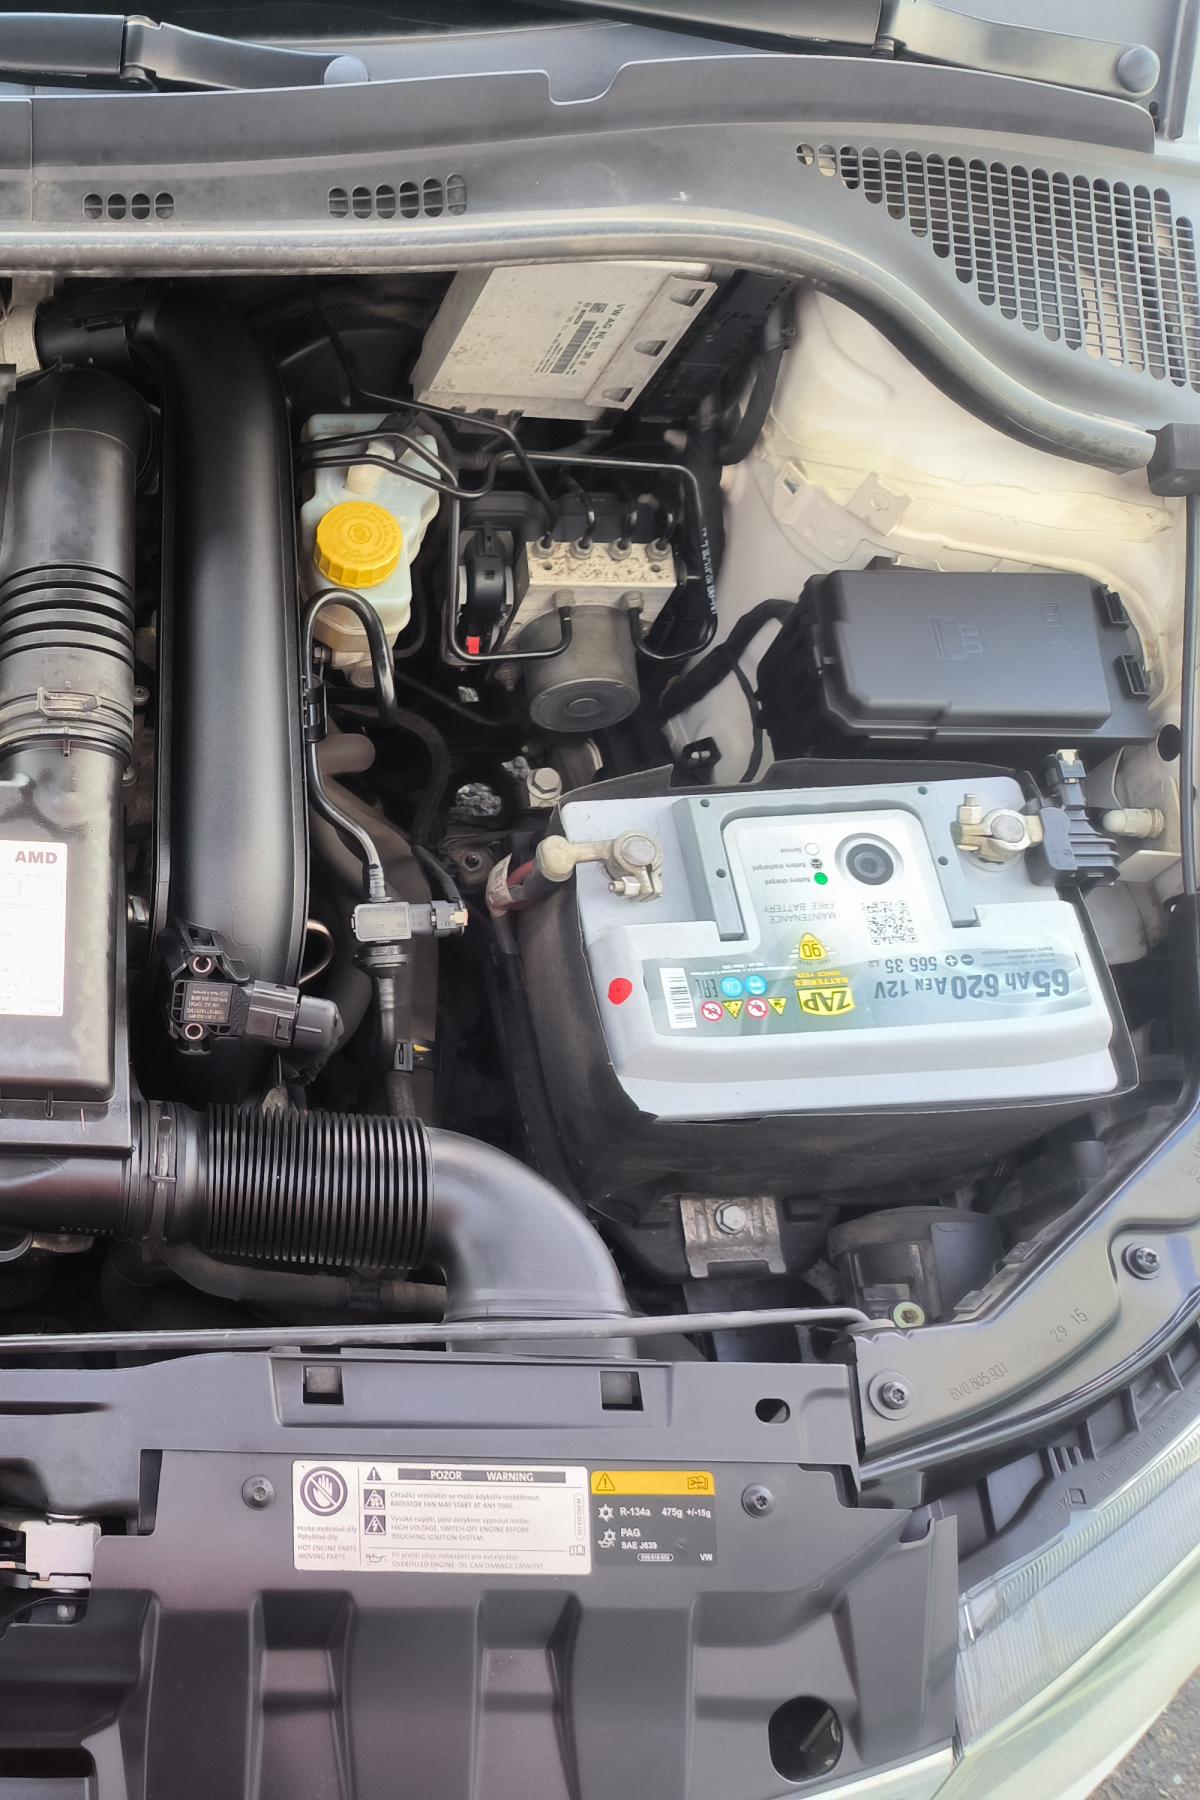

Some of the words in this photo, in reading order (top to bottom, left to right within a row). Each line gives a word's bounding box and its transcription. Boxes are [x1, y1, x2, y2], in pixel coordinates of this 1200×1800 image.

[611, 304, 626, 316] VW
[15, 850, 58, 864] AMD
[764, 902, 806, 913] BATTERY
[812, 901, 835, 910] FREE
[770, 912, 837, 924] MAINTENANCE
[802, 943, 822, 958] 90
[885, 958, 903, 974] 35
[909, 956, 937, 972] 565
[794, 976, 849, 987] BATTERIES
[874, 979, 909, 1000] 12V
[803, 990, 851, 1012] ZAP
[1050, 1325, 1068, 1342] 29
[1070, 1307, 1088, 1326] 15
[430, 1470, 462, 1480] POZOR
[485, 1472, 534, 1482] WARNING
[619, 1506, 651, 1516] R-134a
[661, 1507, 683, 1519] 475g
[686, 1507, 712, 1519] +/-15g
[620, 1528, 641, 1537] PAG
[621, 1541, 638, 1549] SAE
[639, 1541, 658, 1550] J639
[699, 1553, 713, 1561] VW
